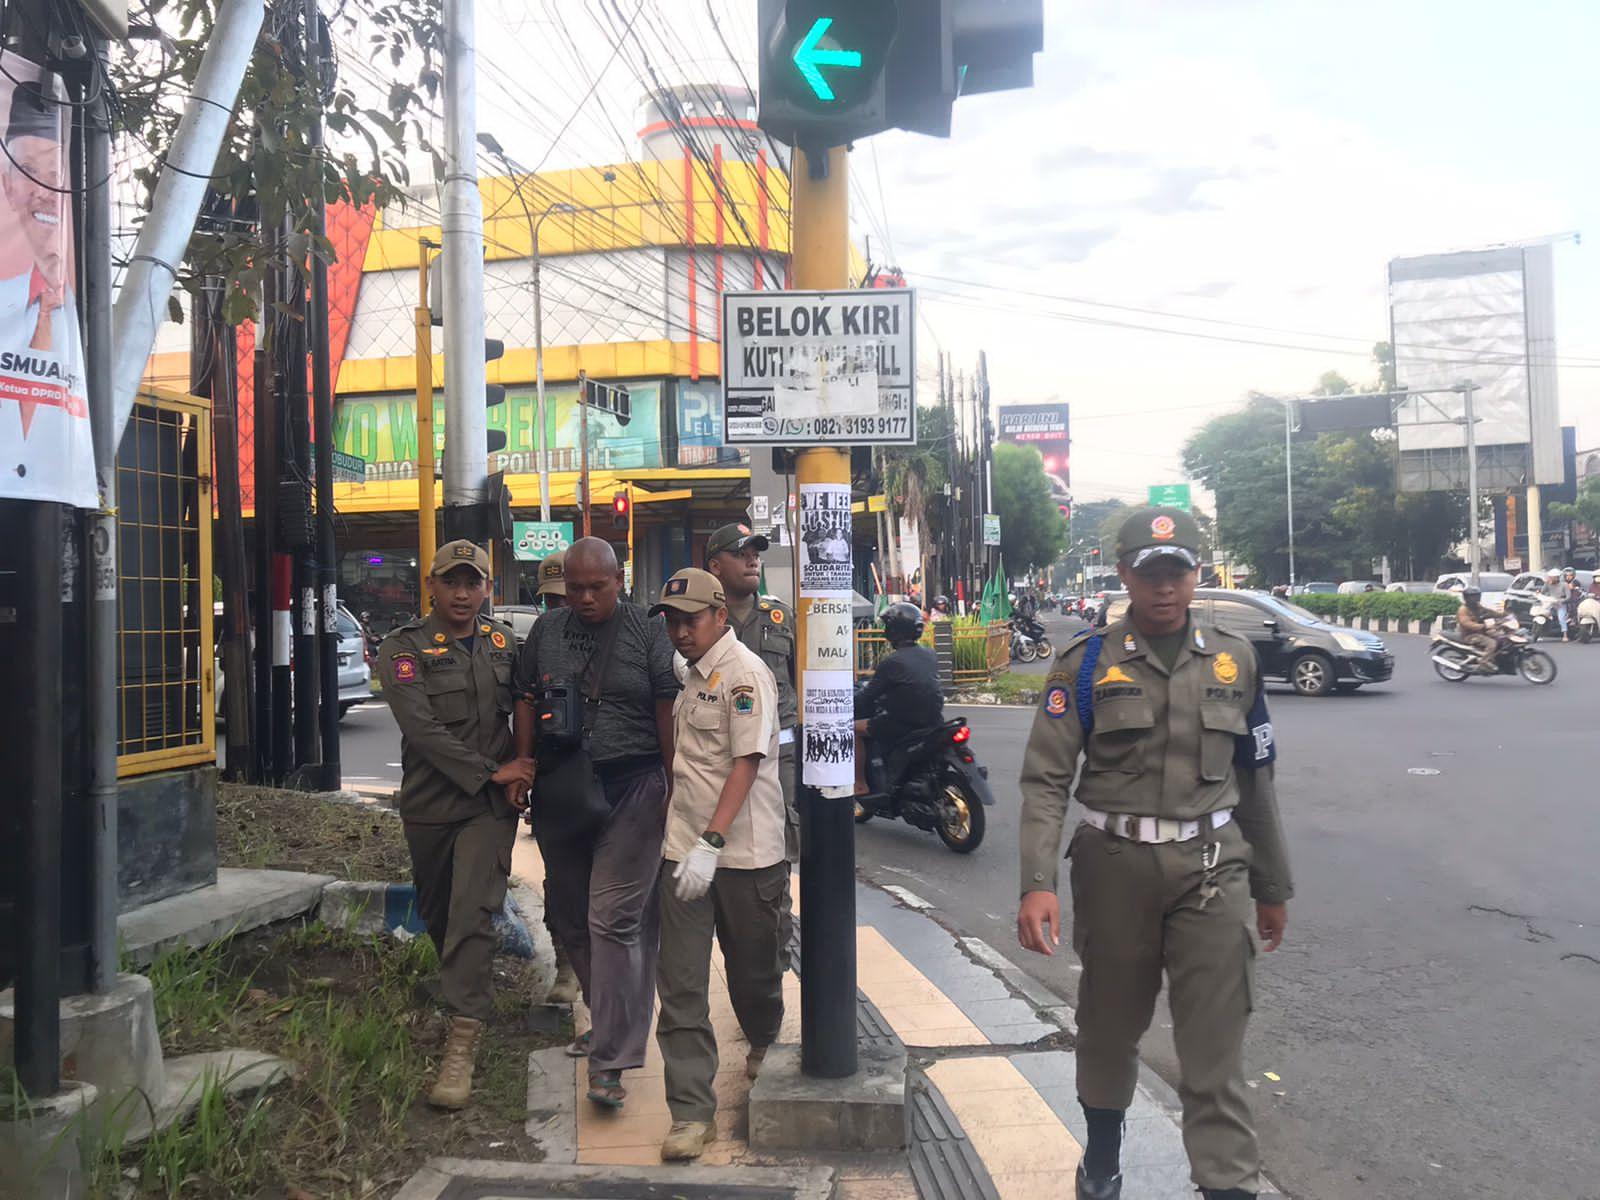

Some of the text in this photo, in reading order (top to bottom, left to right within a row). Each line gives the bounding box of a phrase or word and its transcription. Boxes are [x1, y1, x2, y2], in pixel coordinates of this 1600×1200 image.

[737, 304, 900, 337] BELOK KIRI
[846, 417, 874, 434] 3193
[878, 417, 908, 435] 9177
[805, 492, 825, 511] WE
